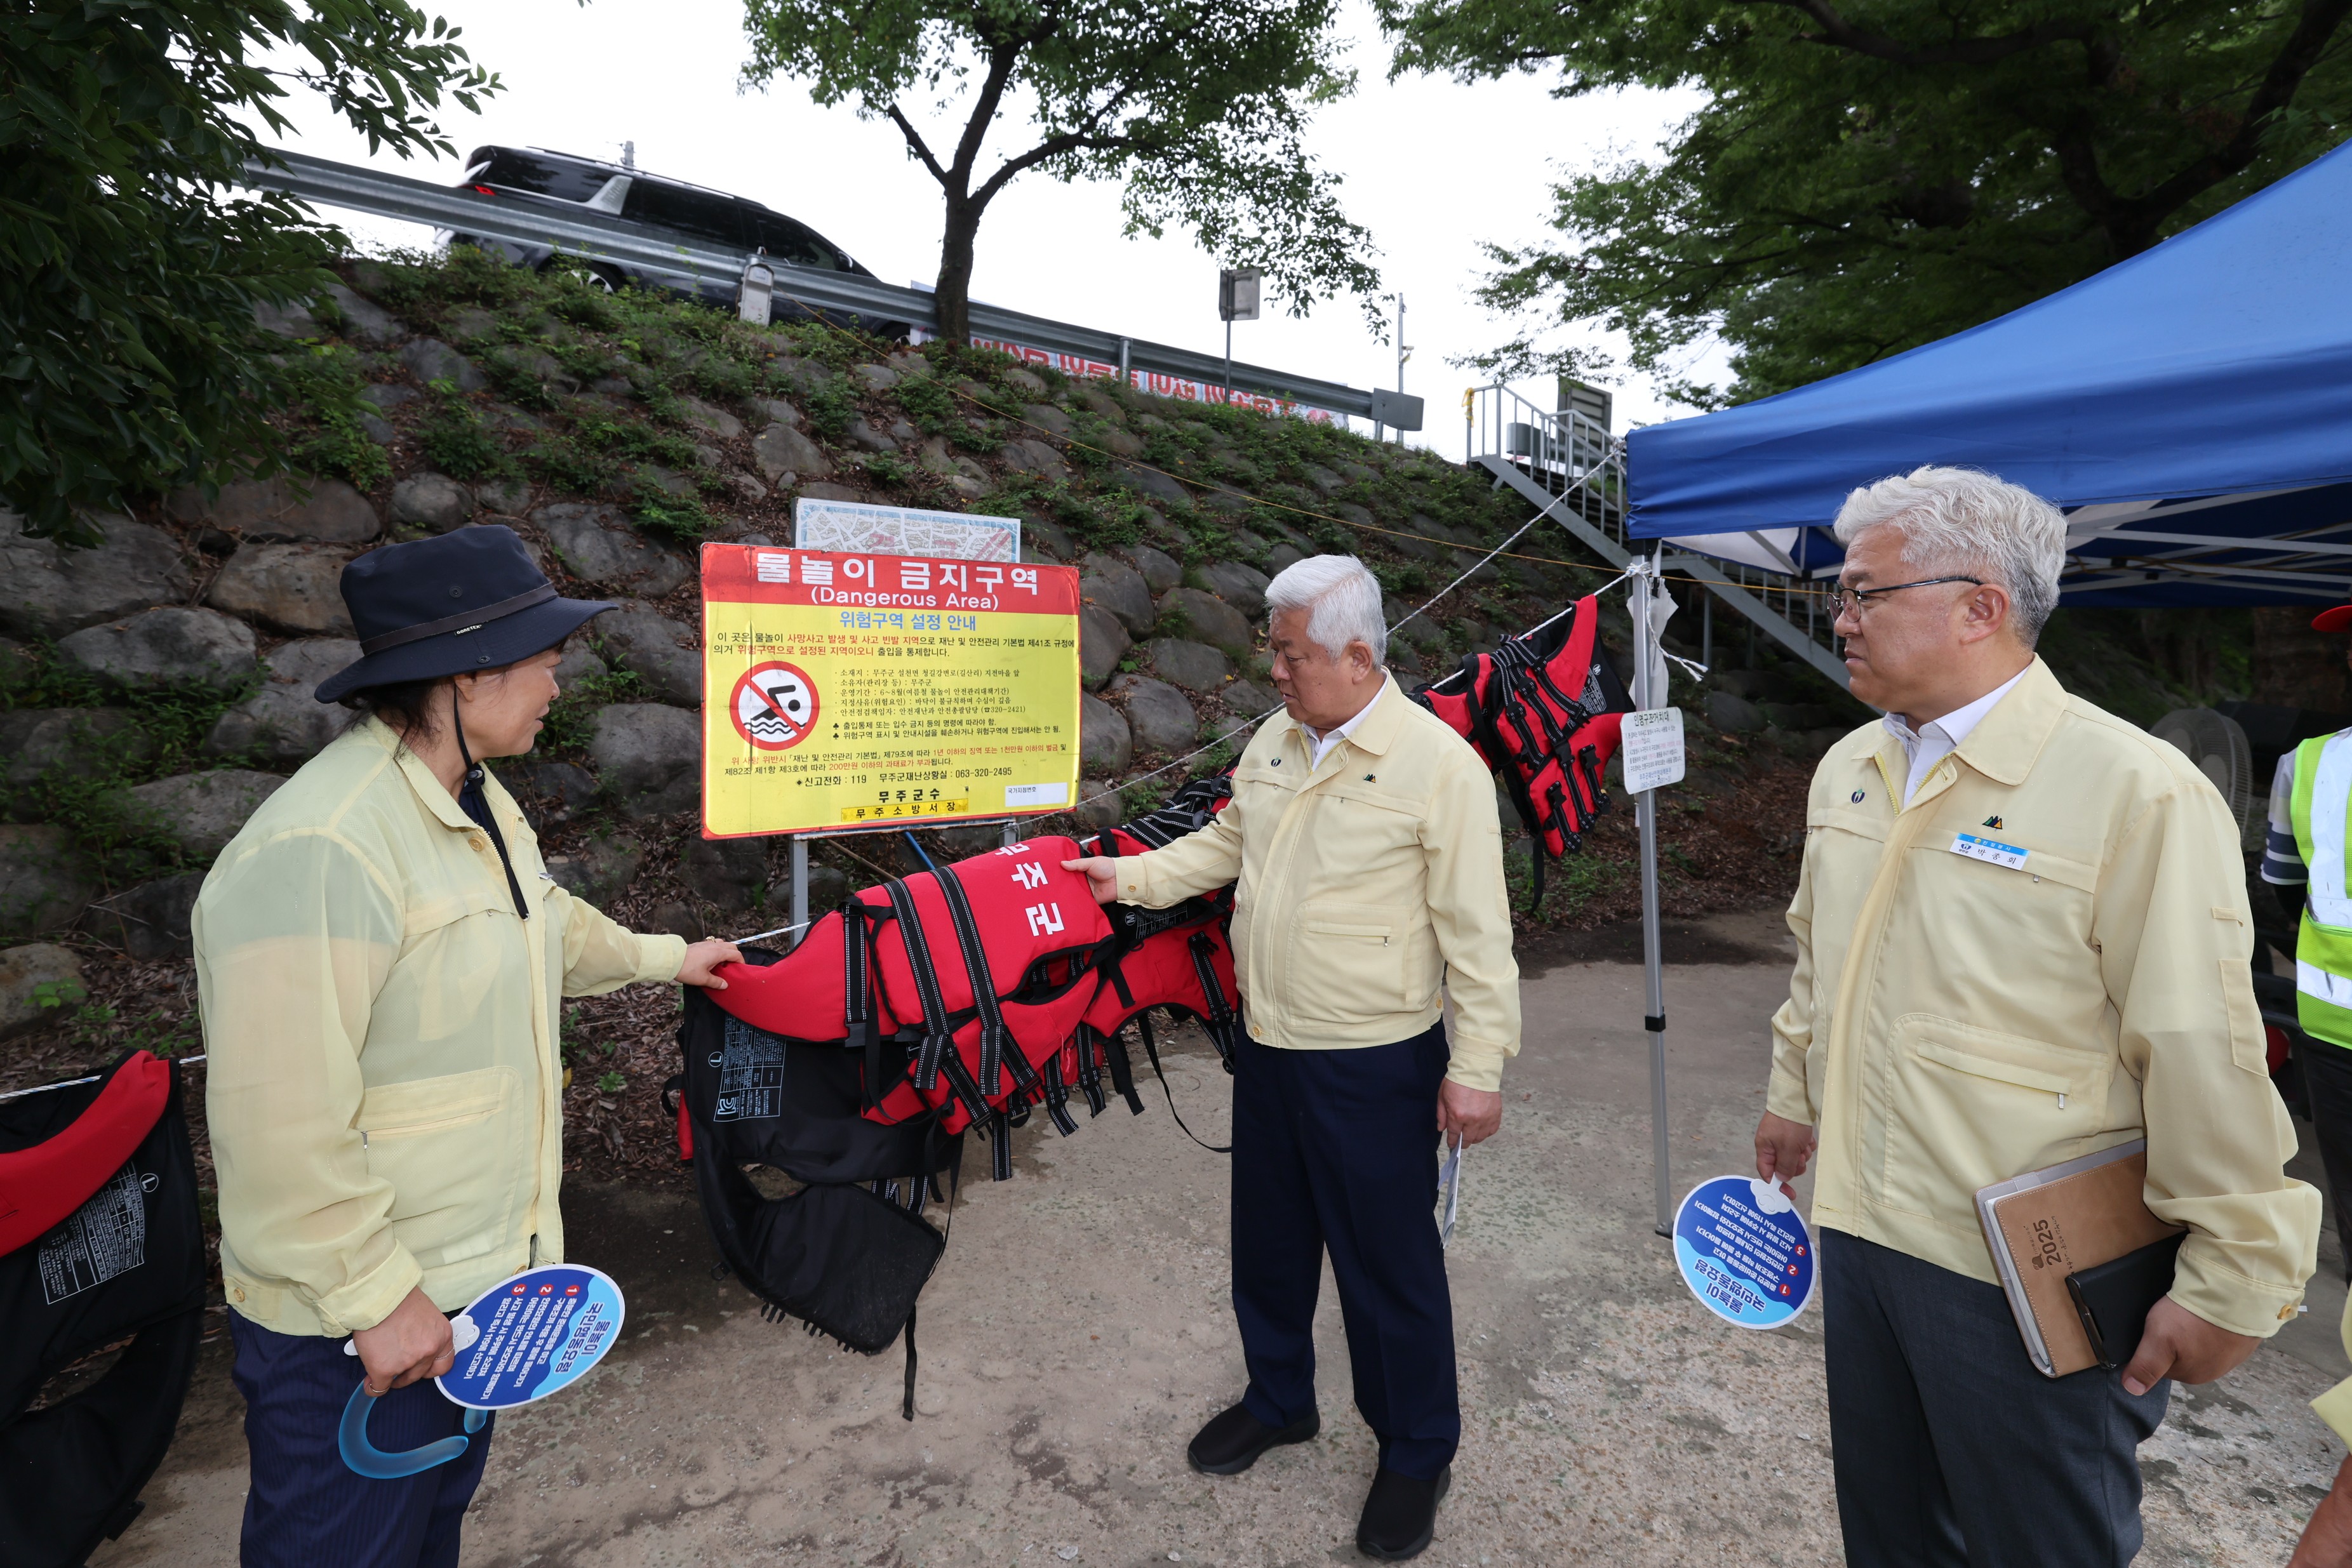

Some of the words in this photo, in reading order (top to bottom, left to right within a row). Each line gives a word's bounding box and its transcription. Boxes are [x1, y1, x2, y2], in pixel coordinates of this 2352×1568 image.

[757, 552, 874, 588] 물놀이
[900, 562, 1038, 595] 금지구역
[811, 587, 936, 608] (Dangerous
[945, 590, 999, 611] Area)
[839, 611, 903, 628] 위험구역
[911, 614, 940, 630] 설정
[947, 615, 976, 631] 안내
[718, 633, 727, 642] 이
[732, 633, 751, 642] 곳은
[755, 633, 783, 643] 물놀이
[787, 634, 824, 643] 사망사고
[828, 635, 846, 644] 발생
[850, 635, 858, 644] 및
[862, 635, 879, 644] 사고
[883, 635, 899, 645] 빈발
[903, 636, 935, 645] 지역으로
[939, 637, 954, 646] 재난
[958, 637, 965, 646] 및
[969, 637, 999, 646] 안전관리
[1003, 638, 1024, 647] 기본법
[1028, 639, 1051, 648] 제41조
[1053, 639, 1074, 648] 규정에
[714, 644, 733, 654] 의거
[737, 645, 795, 655] 위험구역으로
[799, 646, 826, 655] 설정된
[831, 646, 874, 656] 지역이오니
[878, 647, 903, 656] 출입을
[906, 648, 950, 657] 통제합니다.
[841, 679, 888, 687] 소유자(관리장
[880, 688, 927, 696] 6~8월(여름철
[954, 688, 1009, 696] 안전관리대책기간)
[841, 698, 905, 707] 지정사유(위험요인)
[939, 697, 973, 705] 불규칙하며
[840, 708, 895, 716] 안전점검책임자:
[899, 707, 935, 715] 안전재난과
[938, 706, 978, 715] 안전총괄담당
[843, 731, 872, 740] 위험구역
[903, 729, 938, 738] 안내시설을
[940, 728, 973, 736] 훼손하거나
[732, 757, 740, 766] 위
[763, 755, 787, 764] 위반시
[812, 754, 819, 762] 및
[822, 752, 852, 762] 안전관리
[883, 750, 913, 759] 제79조에
[917, 749, 930, 757] 따라
[933, 748, 944, 757] 1년
[947, 748, 966, 756] 이하의
[984, 746, 998, 754] 또는
[1001, 745, 1023, 754] 1천만원
[725, 766, 751, 776] 제82조
[755, 766, 775, 774] 제1항
[780, 764, 808, 773] 제3호에
[829, 762, 858, 771] 200만원
[861, 761, 883, 769] 이하의
[886, 760, 914, 768] 과태료가
[917, 758, 953, 766] 부과됩니다.
[852, 774, 867, 784] 119
[879, 770, 947, 782] 무주군재난상황실
[955, 767, 1012, 778] 063-320-2495
[995, 843, 1065, 936] 무주군
[710, 1055, 723, 1063] L
[141, 1176, 156, 1190] L
[1694, 1200, 1720, 1220] 함께하기
[1720, 1202, 1741, 1218] 소리쳐
[1722, 1193, 1748, 1213] 신고하기
[1739, 1214, 1759, 1232] 주위에
[1747, 1209, 1764, 1223] 119에
[1715, 1223, 1735, 1240] 따르며
[1719, 1215, 1745, 1235] 보호자와
[1758, 1226, 1767, 1235] 시
[1763, 1219, 1777, 1232] 즉시
[1695, 1225, 1722, 1246] 들어가기
[1734, 1235, 1754, 1252] 안내를
[1744, 1230, 1763, 1247] 반드시
[1765, 1231, 1779, 1244] 발생
[1777, 1227, 1796, 1244] 알리고
[2033, 1219, 2062, 1266] 2025
[1713, 1246, 1727, 1259] 하고
[1720, 1240, 1735, 1254] 물에
[1763, 1243, 1788, 1263] 어린이는
[1779, 1239, 1793, 1252] 사고
[1734, 1250, 1742, 1259] 후
[1741, 1254, 1755, 1267] 착용
[1753, 1247, 1784, 1272] 안전요원의
[1726, 1255, 1758, 1280] 준비운동을
[1754, 1262, 1780, 1284] 구명조끼
[1695, 1259, 1765, 1312] 국민행동요령
[1756, 1275, 1777, 1292] 충분한
[1706, 1282, 1743, 1313] 물놀이
[555, 1303, 603, 1372] 국민행동요령
[581, 1321, 611, 1355] 물놀이
